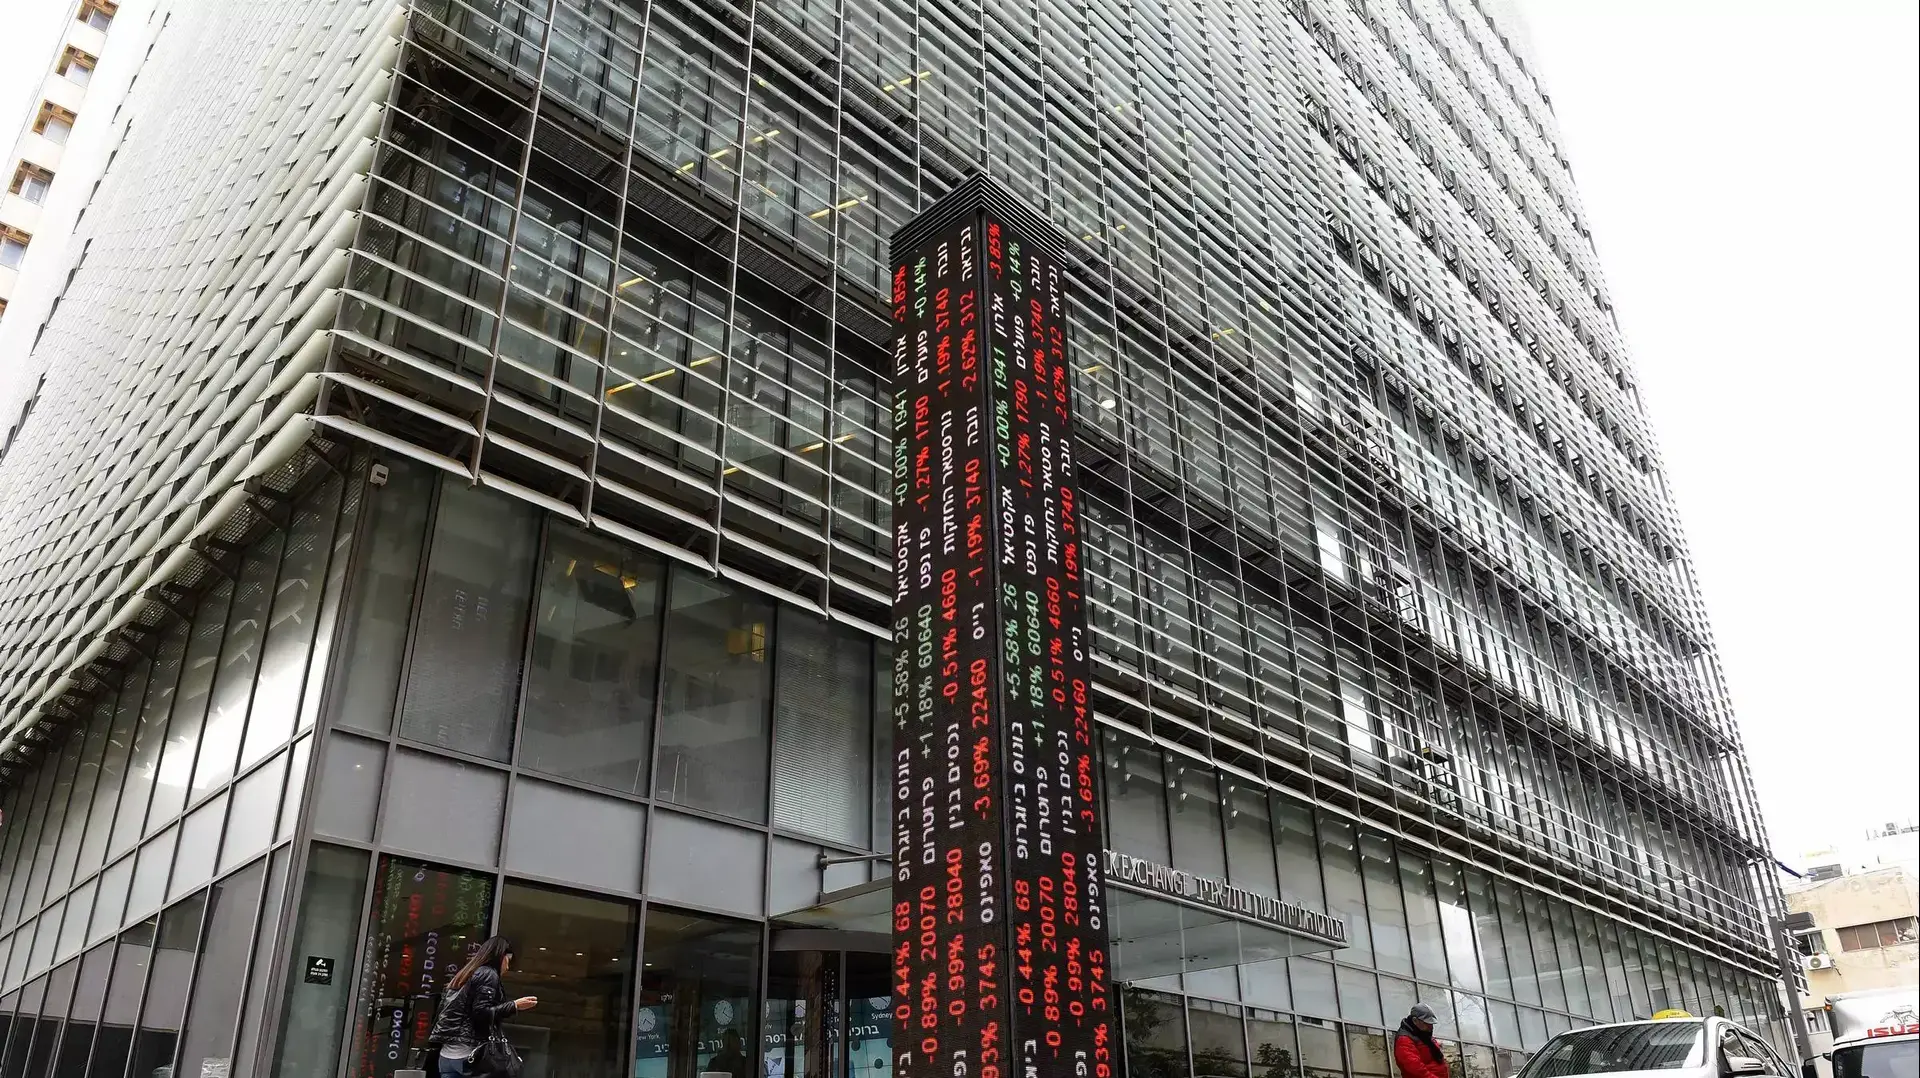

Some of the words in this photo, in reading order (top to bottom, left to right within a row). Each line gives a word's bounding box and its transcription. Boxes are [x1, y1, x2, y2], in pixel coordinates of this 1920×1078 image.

[938, 242, 948, 278] נובה
[961, 226, 972, 281] נבידאה
[988, 223, 1003, 279] -3.85%
[1009, 242, 1022, 301] +0.14%
[1031, 256, 1041, 291] נובה
[892, 265, 906, 323] -3.85%
[915, 257, 927, 318] +0.14%
[936, 288, 949, 332] 3740
[960, 290, 974, 328] 312
[992, 293, 1007, 338] אלרון
[1048, 264, 1060, 318] נבידאה
[1013, 315, 1026, 369] פועלים
[1031, 299, 1044, 342] 3740
[1050, 327, 1062, 359] 312
[895, 335, 909, 376] אלרון
[915, 330, 928, 383] פועלים
[937, 336, 950, 397] -1.19%
[961, 329, 977, 392] -2.62%
[993, 347, 1007, 389] 1941
[1033, 349, 1047, 407] -1.19%
[895, 389, 907, 431] 1941
[915, 396, 928, 440] 1790
[1015, 380, 1029, 422] 1790
[1053, 365, 1067, 424] -2.62%
[941, 410, 954, 483] נורסטאר
[967, 406, 978, 446] נובה
[995, 401, 1010, 468] +0.00%
[895, 438, 907, 506] +0.00%
[916, 446, 930, 512] -1.27%
[965, 459, 981, 509] 3740
[1018, 434, 1032, 497] -1.27%
[1040, 423, 1052, 491] נורסטאר
[1060, 439, 1071, 476] נובה
[919, 527, 931, 547] פז
[943, 483, 957, 555] החזקות
[1002, 486, 1016, 564] אקסטיאל
[1025, 515, 1035, 534] פז
[1044, 497, 1059, 564] החזקות
[1061, 487, 1074, 534] 3740
[895, 522, 911, 603] אקסטיאל
[920, 553, 931, 589] נפט
[967, 514, 983, 586] -1.19%
[1026, 541, 1037, 575] נפט
[1065, 543, 1079, 610] -1.19%
[942, 569, 956, 621] 4660
[972, 603, 984, 639] נייס
[1004, 582, 1017, 610] 26
[1026, 591, 1041, 655] 60640
[1046, 577, 1061, 629] 4660
[896, 617, 908, 643] 26
[918, 605, 932, 668] 60640
[1005, 619, 1020, 700] +5.58%
[1072, 627, 1083, 661] נייס
[895, 650, 909, 729] +5.58%
[943, 628, 958, 704] -0.51%
[970, 659, 988, 728] 22460
[1050, 638, 1065, 710] -0.51%
[919, 676, 933, 758] +1.18%
[1030, 665, 1044, 746] +1.18%
[1073, 679, 1089, 745] 22460
[898, 748, 909, 799] בונוס
[948, 723, 960, 783] נכסים
[973, 736, 990, 819] -3.69%
[1012, 722, 1024, 774] בונוס
[1057, 731, 1070, 788] נכסים
[923, 777, 935, 864] פרוטרום
[949, 788, 964, 828] בנין
[1015, 784, 1028, 859] ביוגרופ
[1037, 767, 1051, 855] פרוטרום
[1061, 796, 1076, 834] בנין
[1077, 755, 1093, 832] -3.69%
[899, 807, 910, 881] ביוגרופ
[946, 848, 963, 924] 28040
[979, 842, 994, 923] סאפינס
[1015, 880, 1030, 911] 68
[1062, 852, 1079, 925] 28040
[1087, 854, 1100, 929] סאפינס
[1120, 854, 1191, 897] EXCHANGE
[896, 902, 910, 931] 68
[920, 886, 936, 961] 20070
[1039, 876, 1056, 952] 20070
[896, 941, 911, 1029] -0.44%
[948, 934, 966, 1025] -0.99%
[978, 944, 997, 1010] 3745
[1017, 923, 1034, 1014] -0.44%
[1067, 938, 1084, 1026] -0.99%
[1089, 950, 1106, 1010] 3745
[849, 1025, 880, 1036] ברוכי
[871, 1012, 893, 1020] Sydney
[921, 972, 937, 1063] -0.89%
[1043, 965, 1061, 1057] -0.89%
